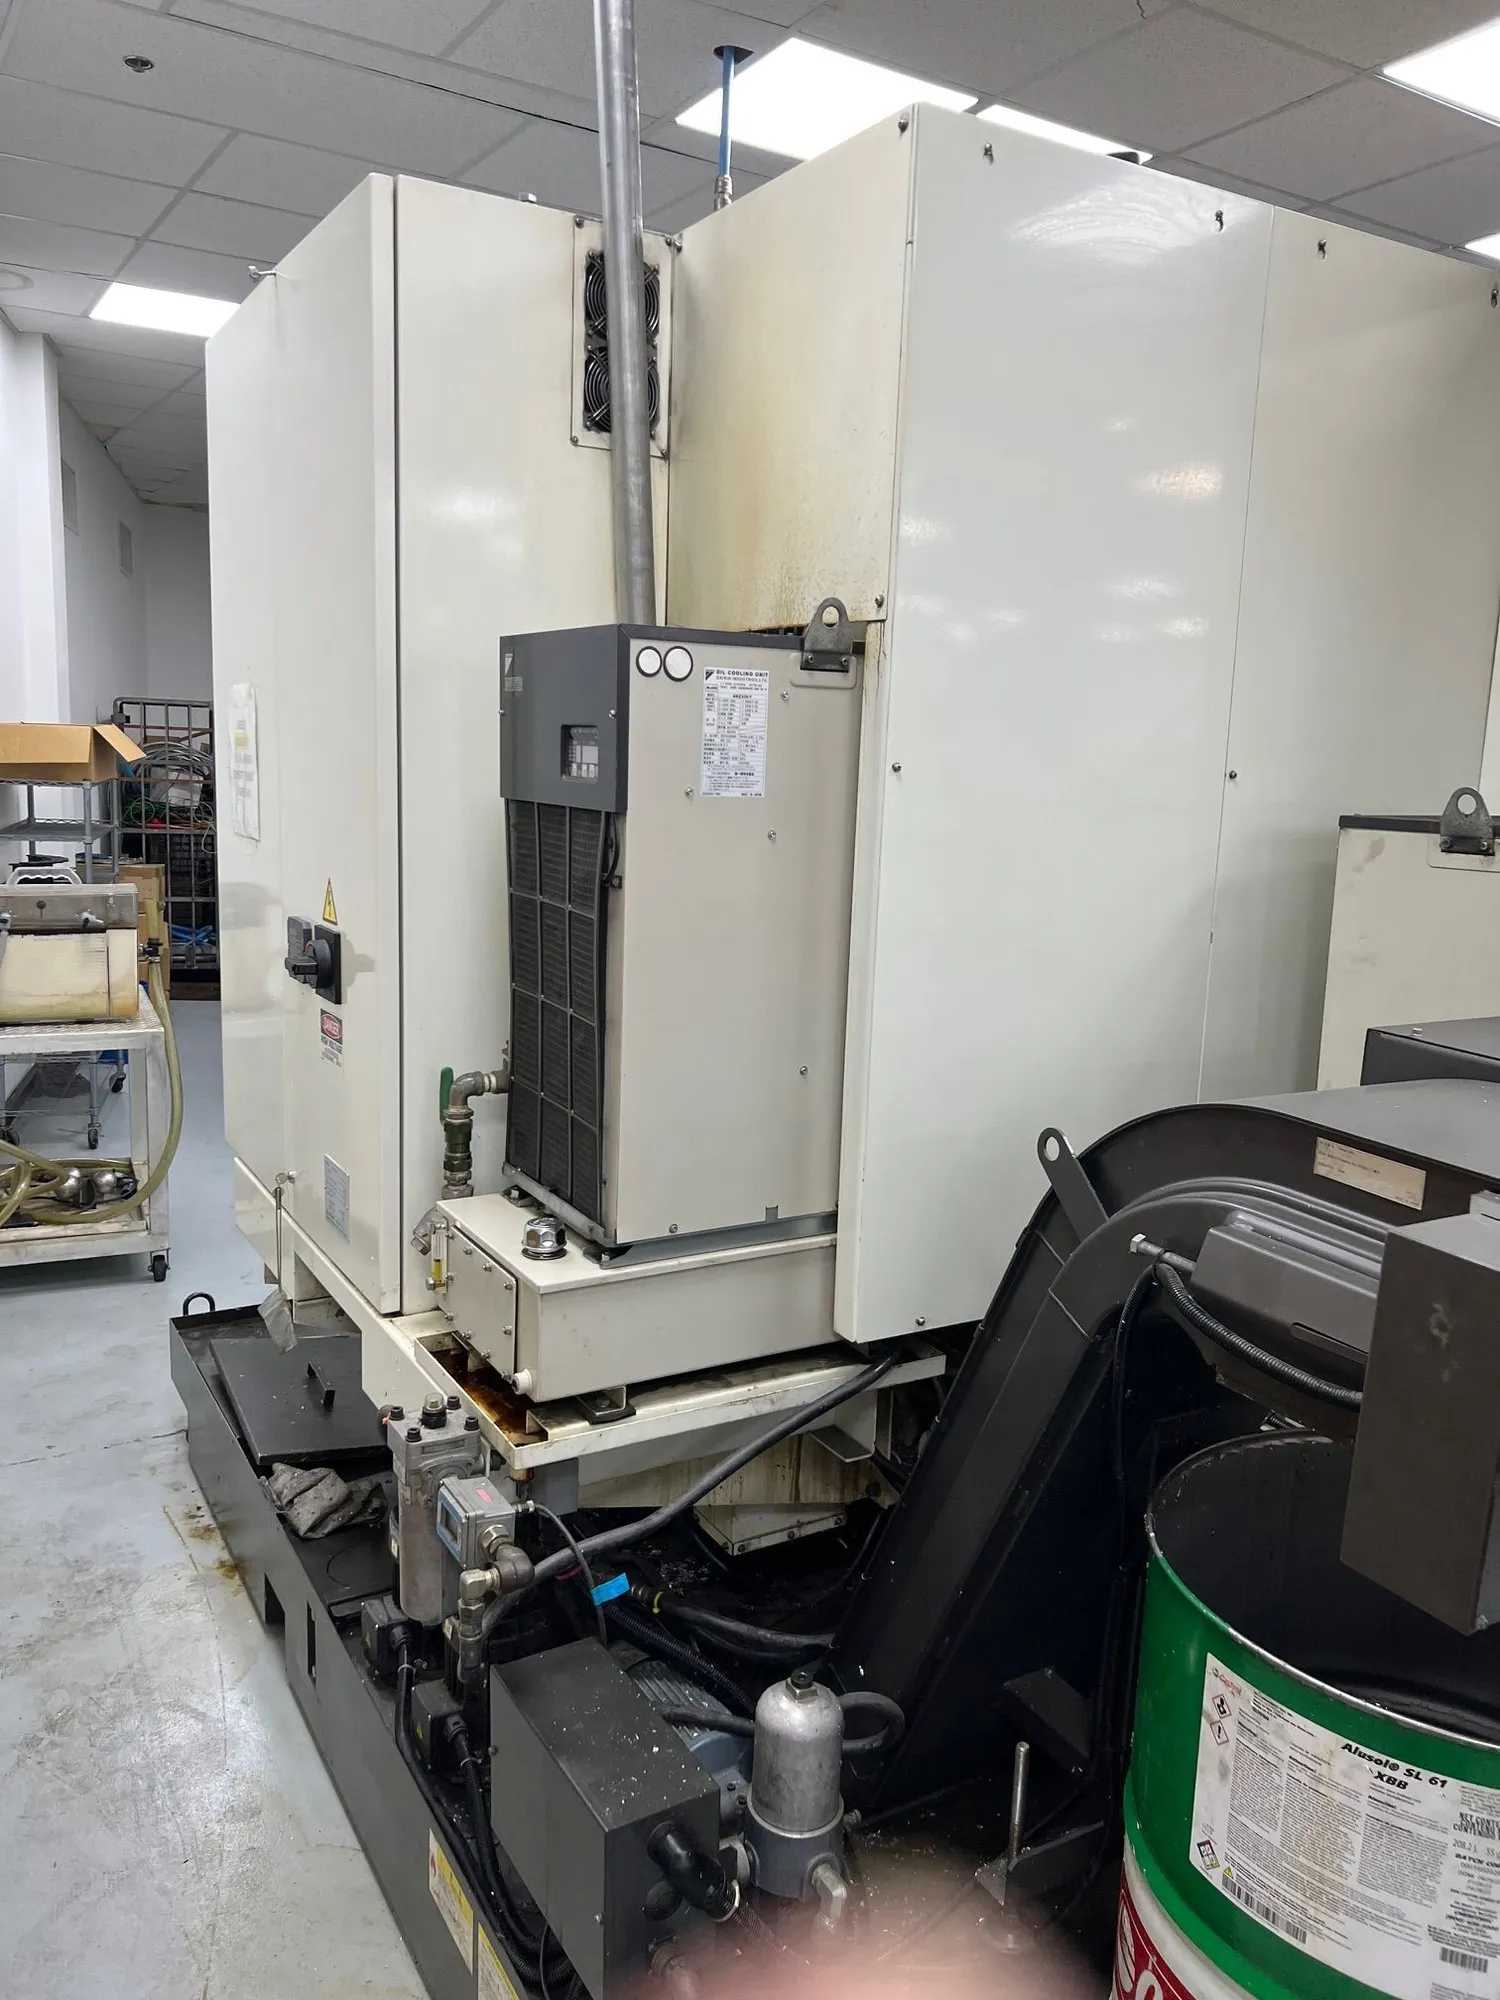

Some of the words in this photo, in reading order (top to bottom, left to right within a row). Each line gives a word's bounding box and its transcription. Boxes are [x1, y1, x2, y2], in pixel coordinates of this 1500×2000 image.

[1374, 1771, 1409, 1790] XBB
[1403, 1768, 1423, 1781] SL
[1428, 1776, 1448, 1789] 61
